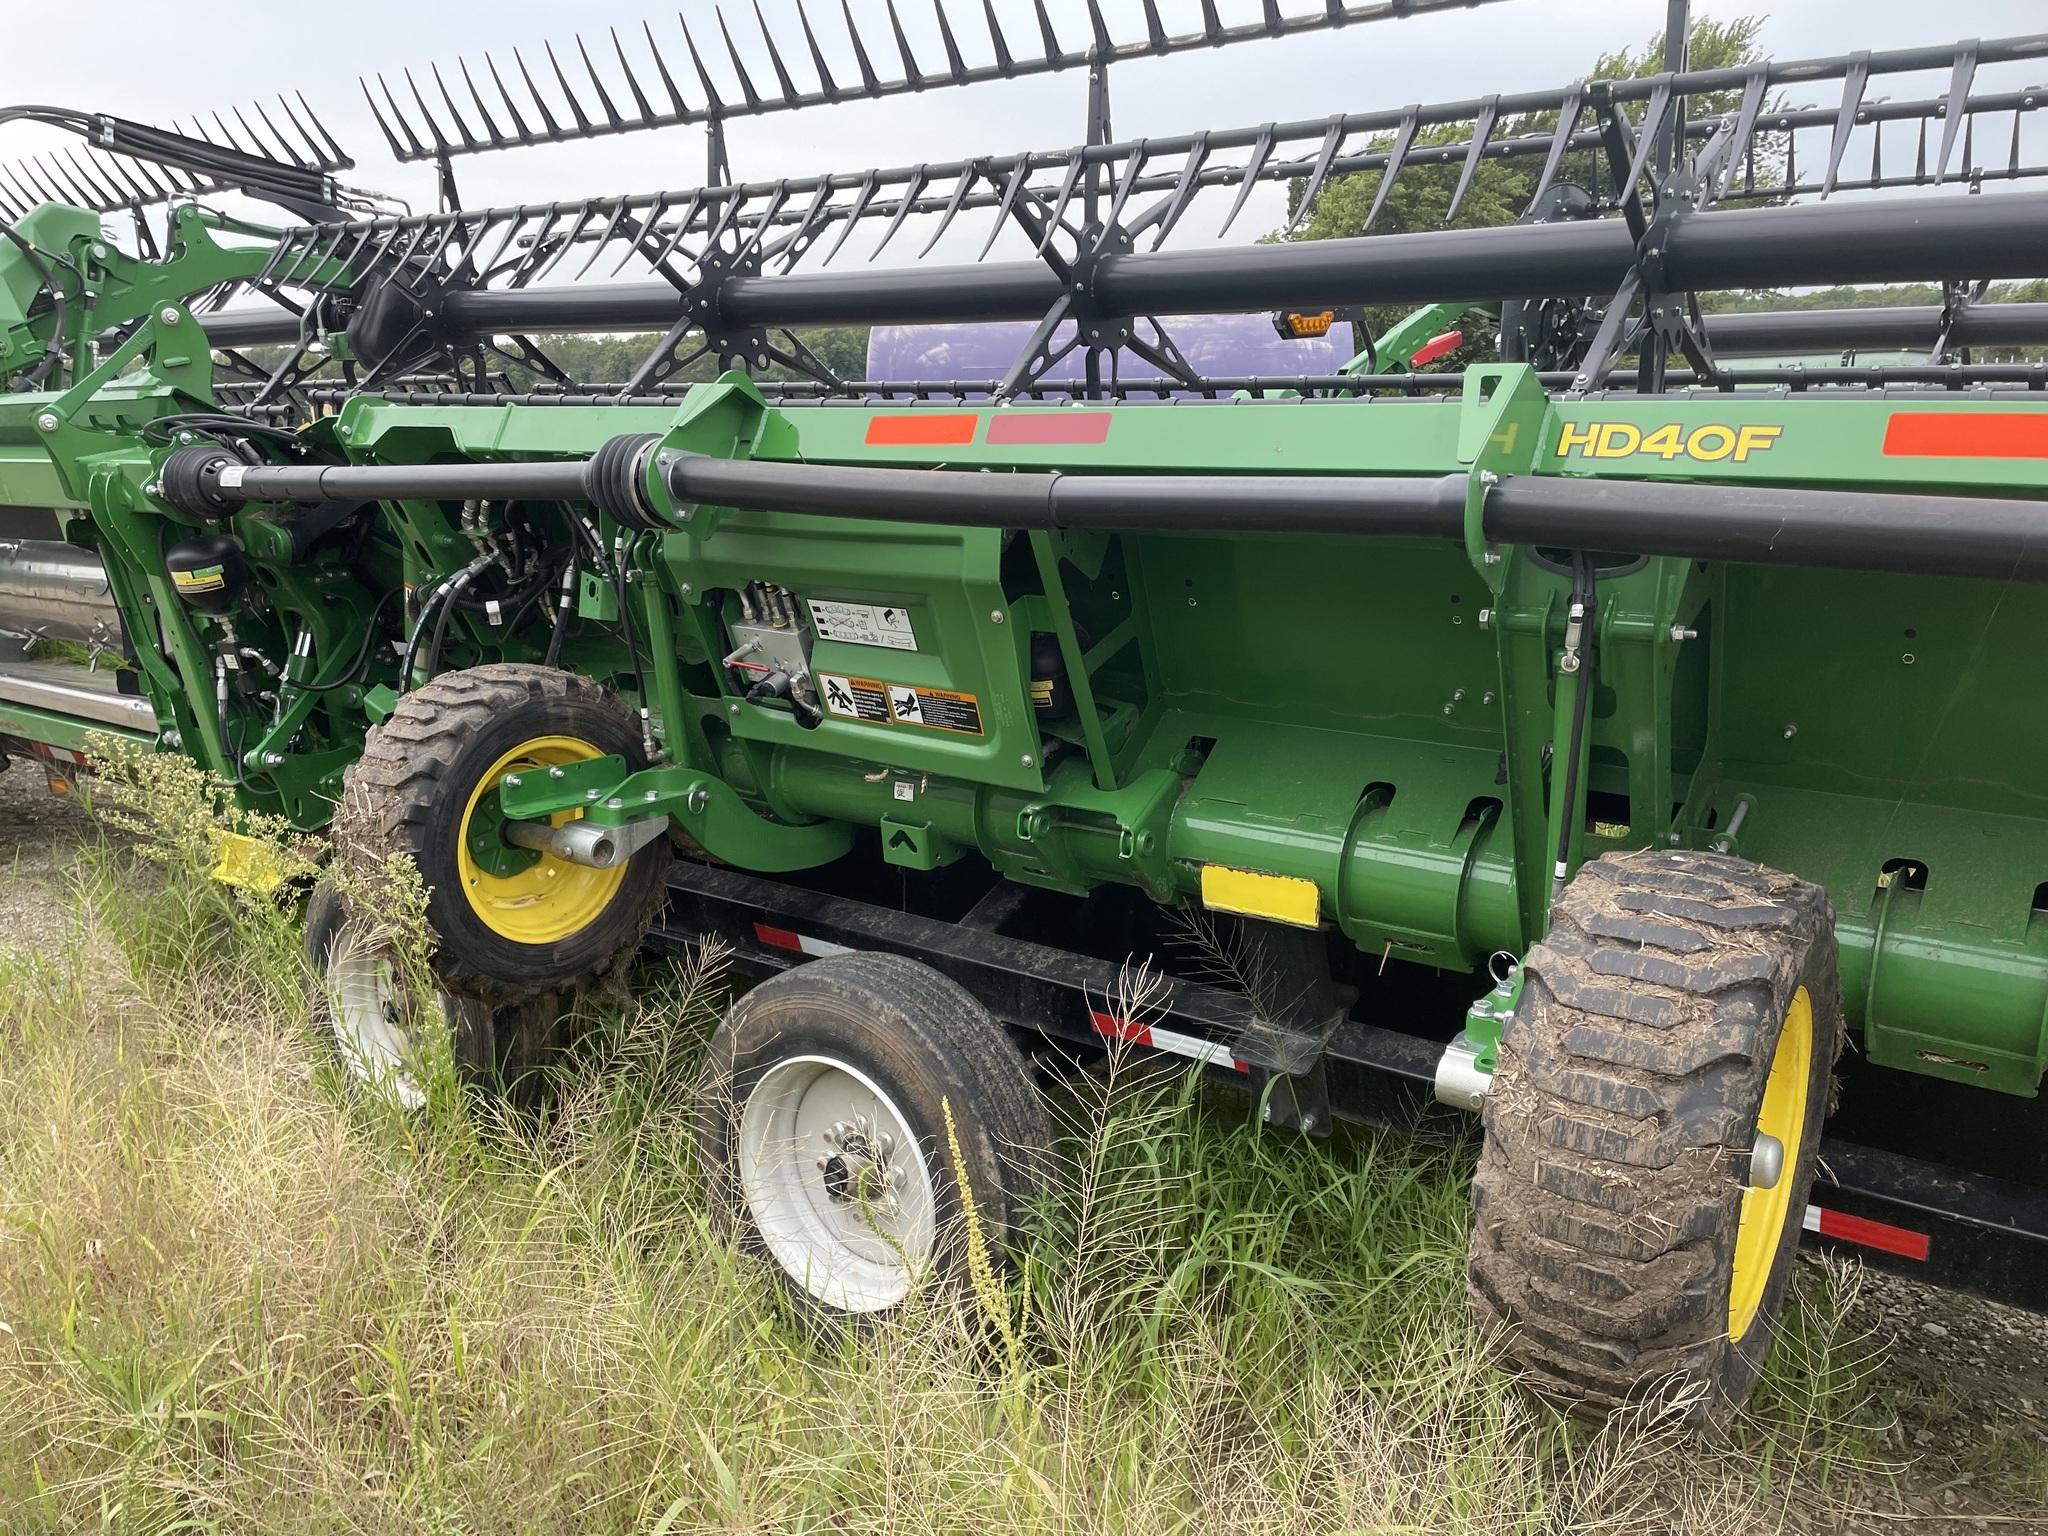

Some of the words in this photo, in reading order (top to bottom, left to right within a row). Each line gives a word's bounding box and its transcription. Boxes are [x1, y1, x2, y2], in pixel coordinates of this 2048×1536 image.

[1555, 422, 1783, 462] HD40F
[855, 680, 882, 690] WARNING
[935, 691, 961, 700] WARNING
